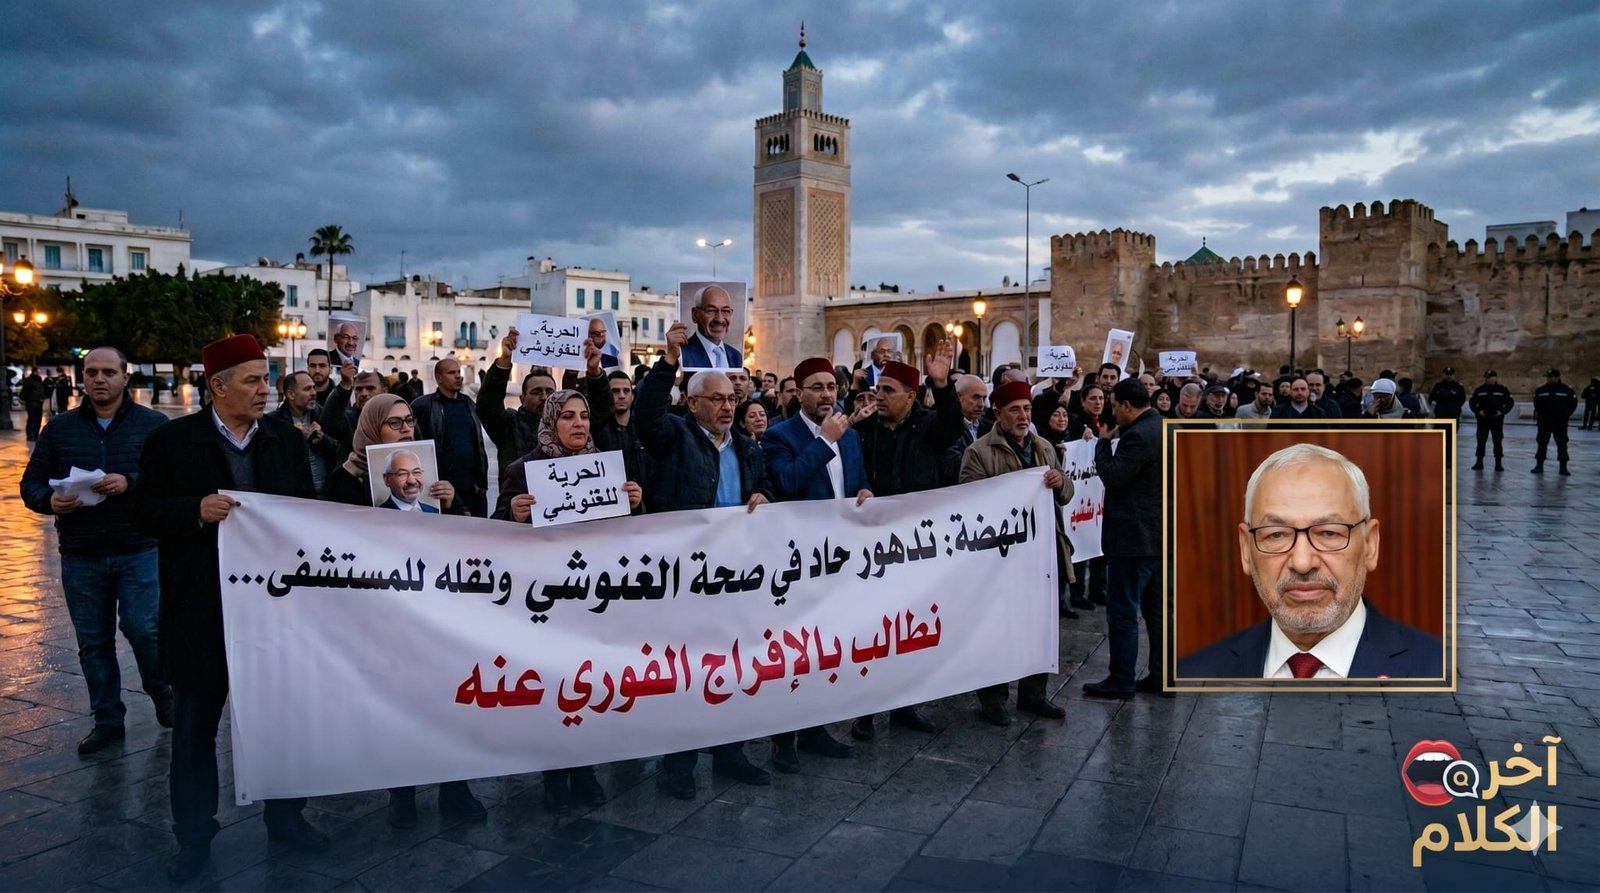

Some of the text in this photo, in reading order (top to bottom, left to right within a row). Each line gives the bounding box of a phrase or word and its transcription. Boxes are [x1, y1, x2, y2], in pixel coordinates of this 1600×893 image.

[540, 320, 579, 338] الحرية
[547, 460, 606, 488] الحرية
[857, 519, 937, 579] تدهور
[945, 506, 1036, 557] النهضة:
[434, 558, 513, 606] ونقله
[689, 551, 765, 596] صحة
[770, 539, 802, 607] في
[809, 537, 851, 578] حاد
[525, 549, 681, 624] الغنوشي
[454, 603, 942, 728] نطالب بالإفراج الفوري عنه
